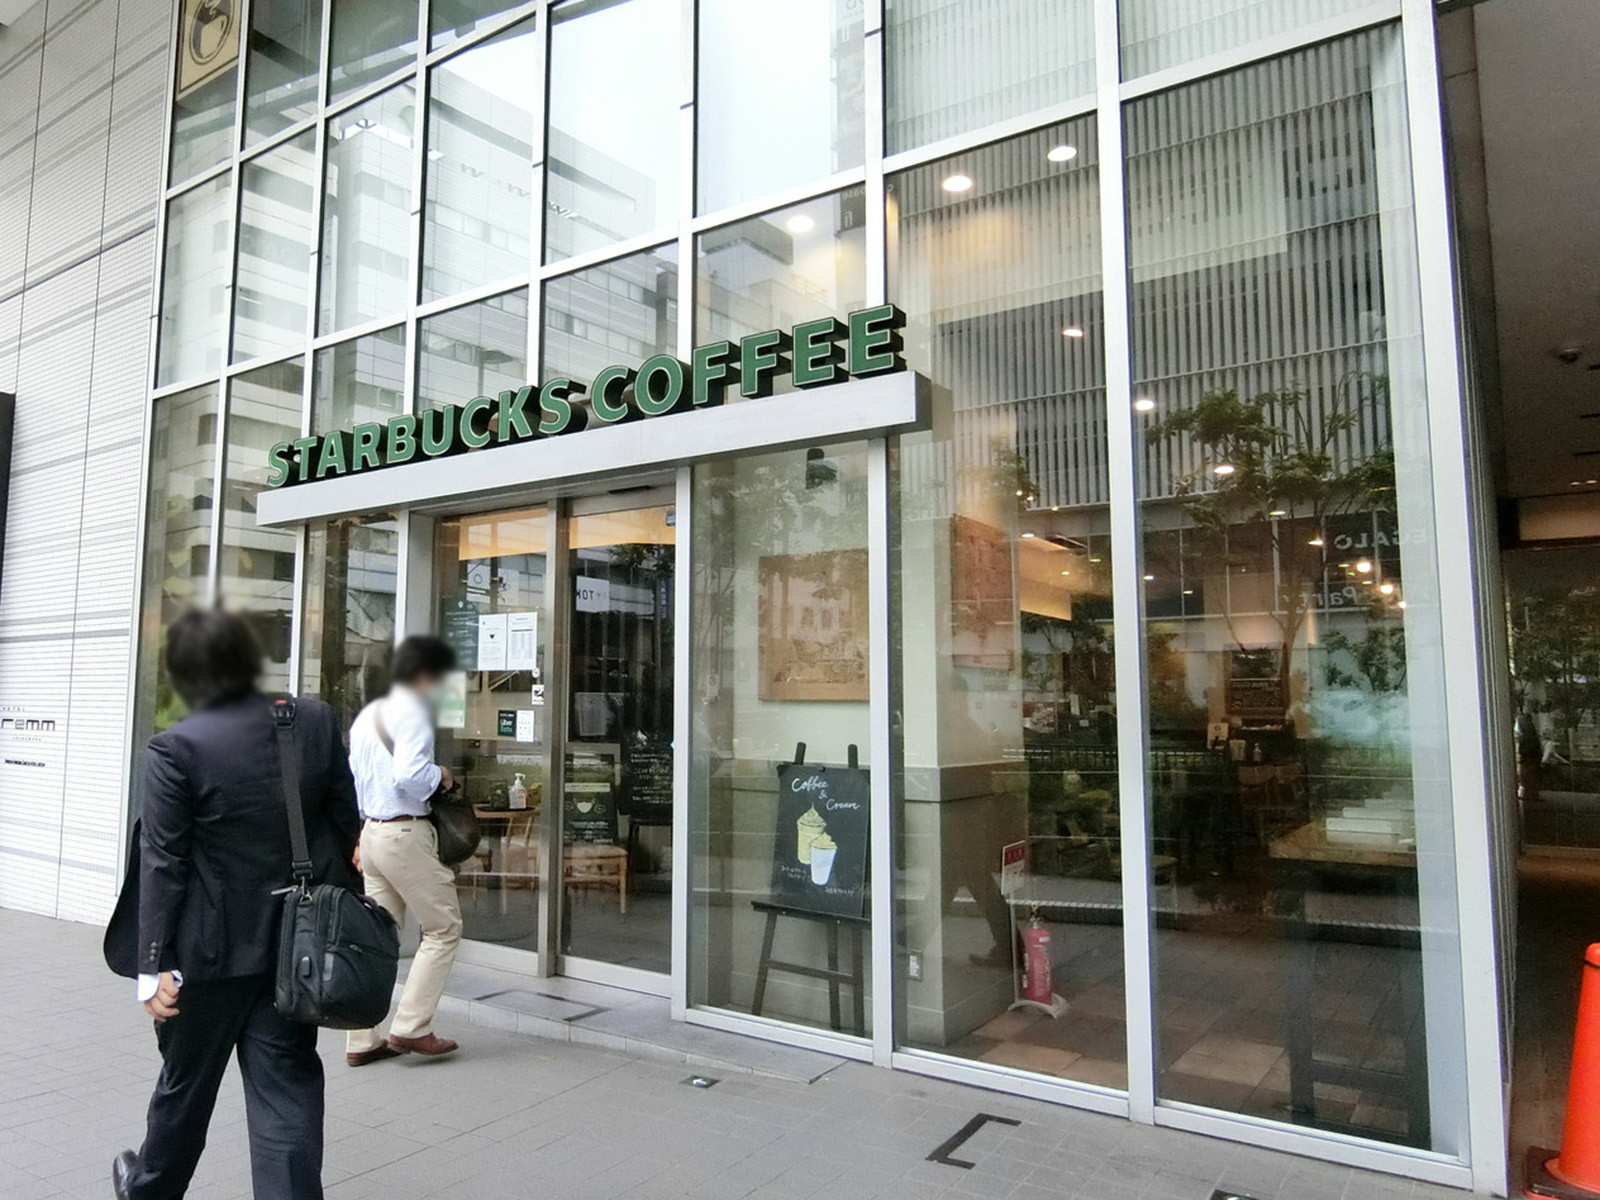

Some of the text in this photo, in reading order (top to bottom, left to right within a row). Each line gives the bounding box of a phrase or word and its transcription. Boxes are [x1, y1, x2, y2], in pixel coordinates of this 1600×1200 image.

[267, 304, 897, 487] STARBUCKS COFFEE
[1, 718, 56, 731] remm
[791, 775, 829, 792] Coffee
[818, 789, 828, 800] &
[825, 798, 861, 811] Cream
